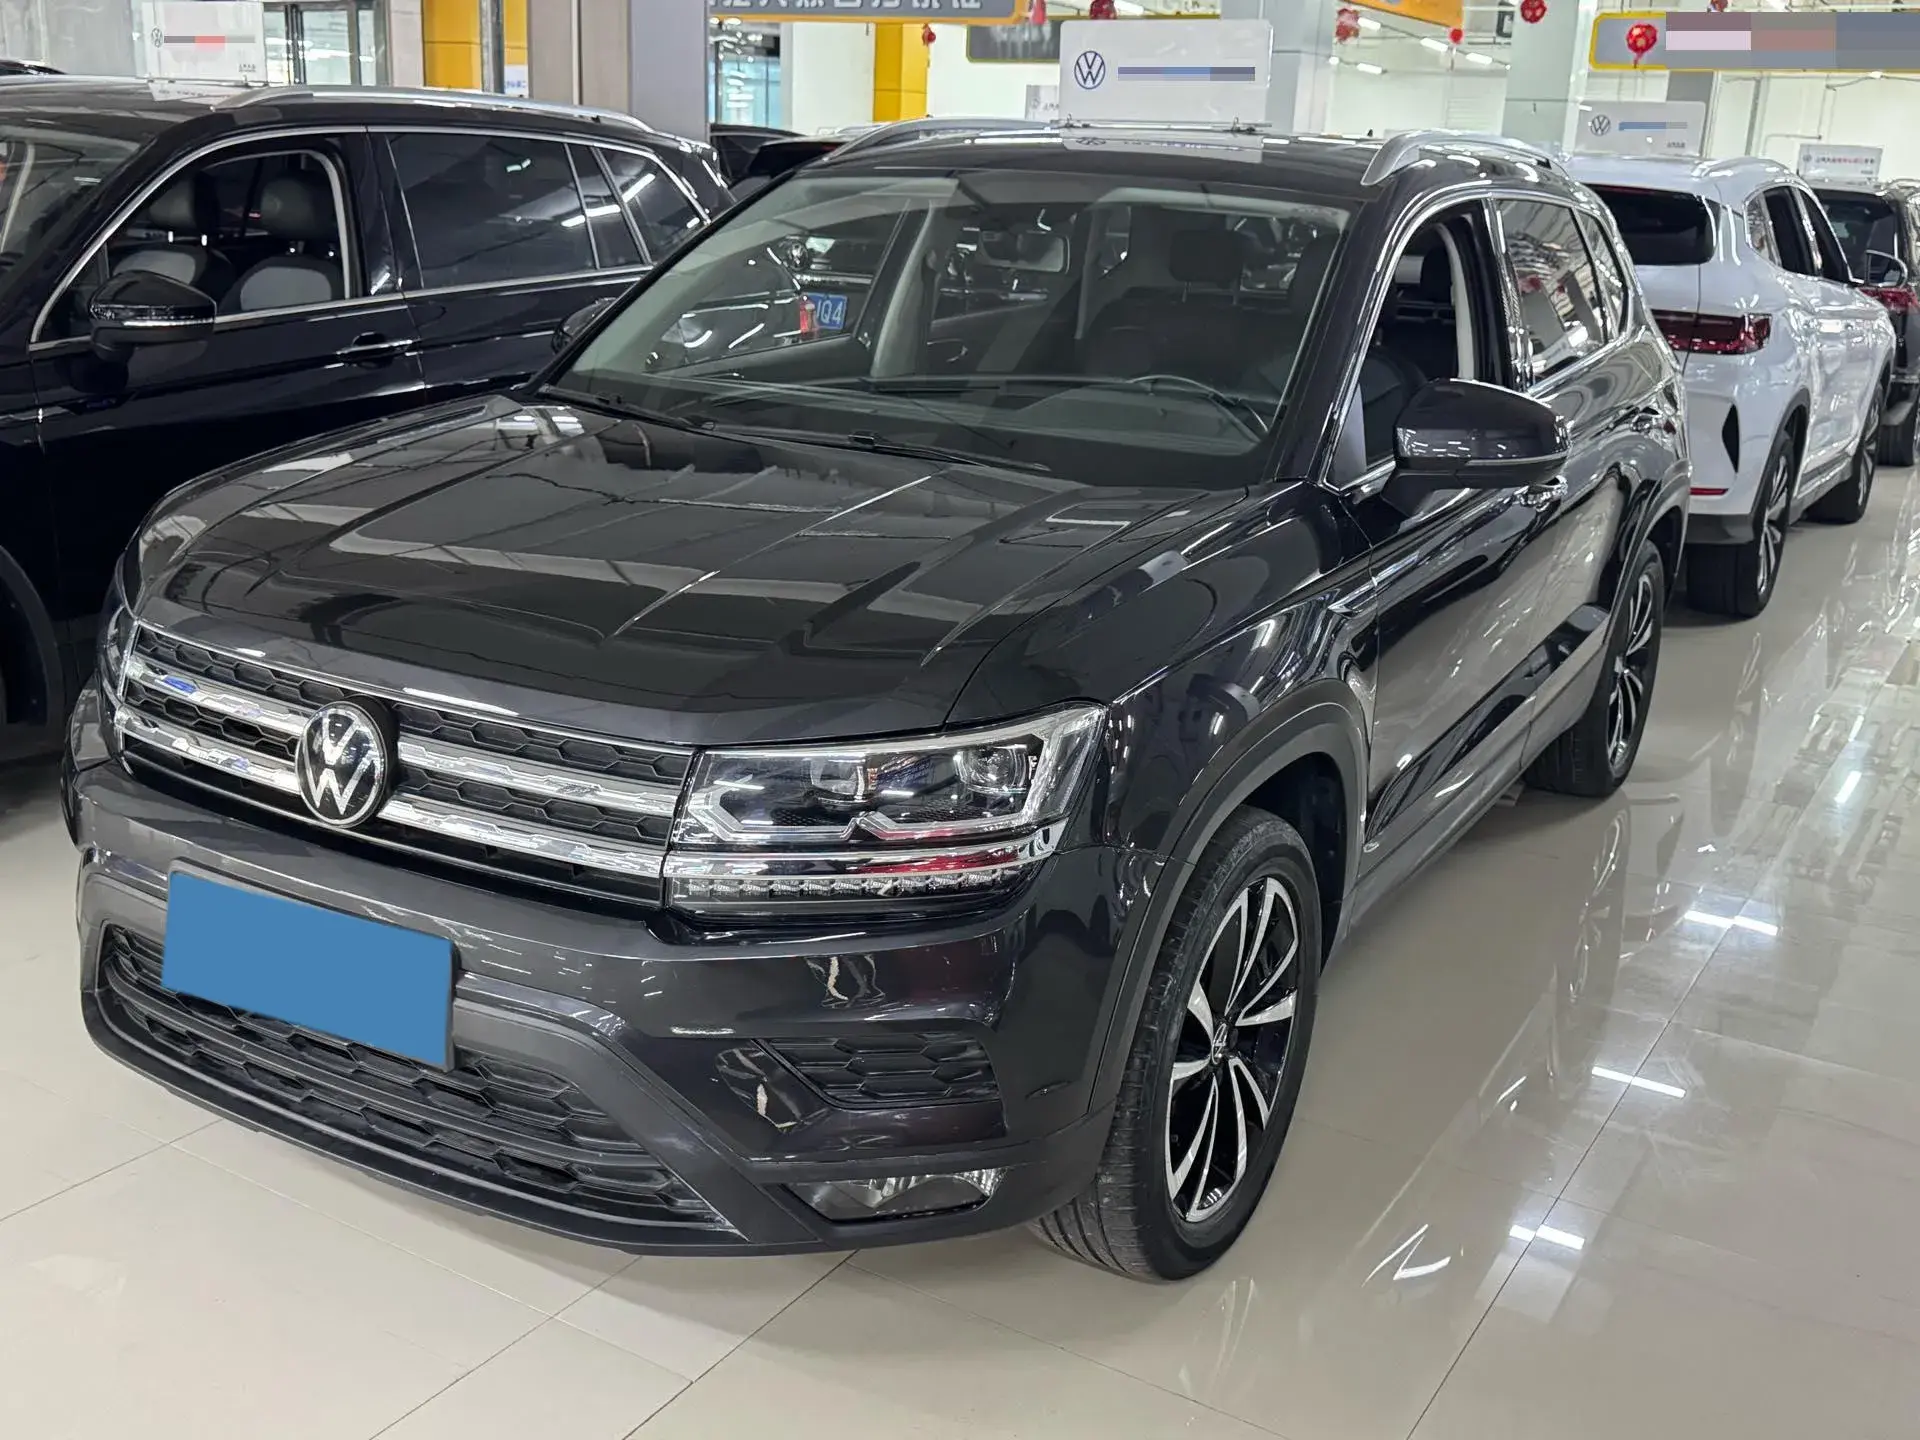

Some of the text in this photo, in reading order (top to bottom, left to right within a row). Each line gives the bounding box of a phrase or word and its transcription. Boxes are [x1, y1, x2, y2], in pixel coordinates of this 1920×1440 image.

[1074, 51, 1106, 89] VW
[1590, 115, 1611, 136] VW
[297, 704, 385, 824] VW
